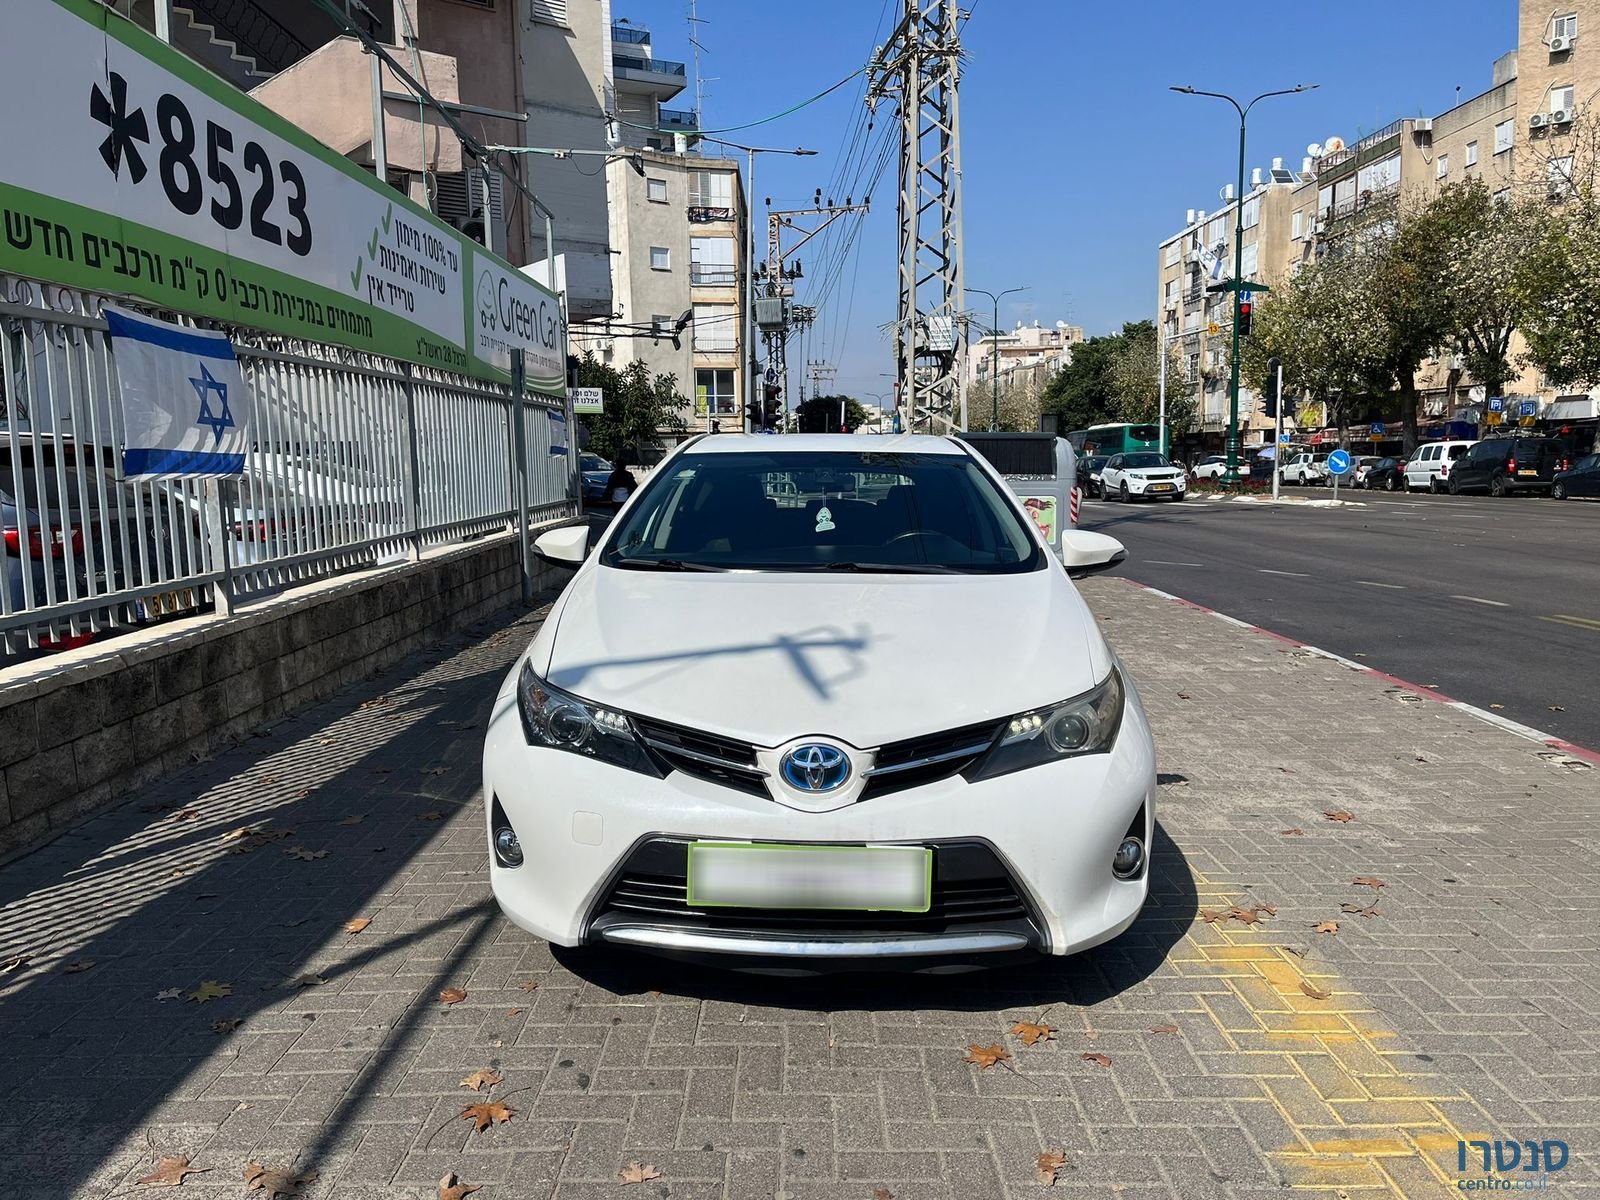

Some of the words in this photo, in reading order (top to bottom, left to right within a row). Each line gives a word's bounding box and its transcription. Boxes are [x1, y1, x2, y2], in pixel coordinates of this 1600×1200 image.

[395, 219, 421, 252] מימון
[423, 233, 446, 266] 100%
[82, 232, 164, 285] ורכבים
[380, 245, 418, 283] ואמינות
[447, 250, 458, 272] עד
[215, 268, 227, 302] 0
[231, 278, 269, 313] רכבי
[367, 274, 385, 305] אין
[420, 265, 446, 295] שירות
[272, 290, 325, 326] במכירת
[387, 282, 414, 312] טרייד
[326, 305, 373, 338] מתמחים
[498, 277, 538, 343] Green
[540, 300, 557, 351] Car
[443, 345, 452, 363] 28
[451, 346, 467, 367] הרצל
